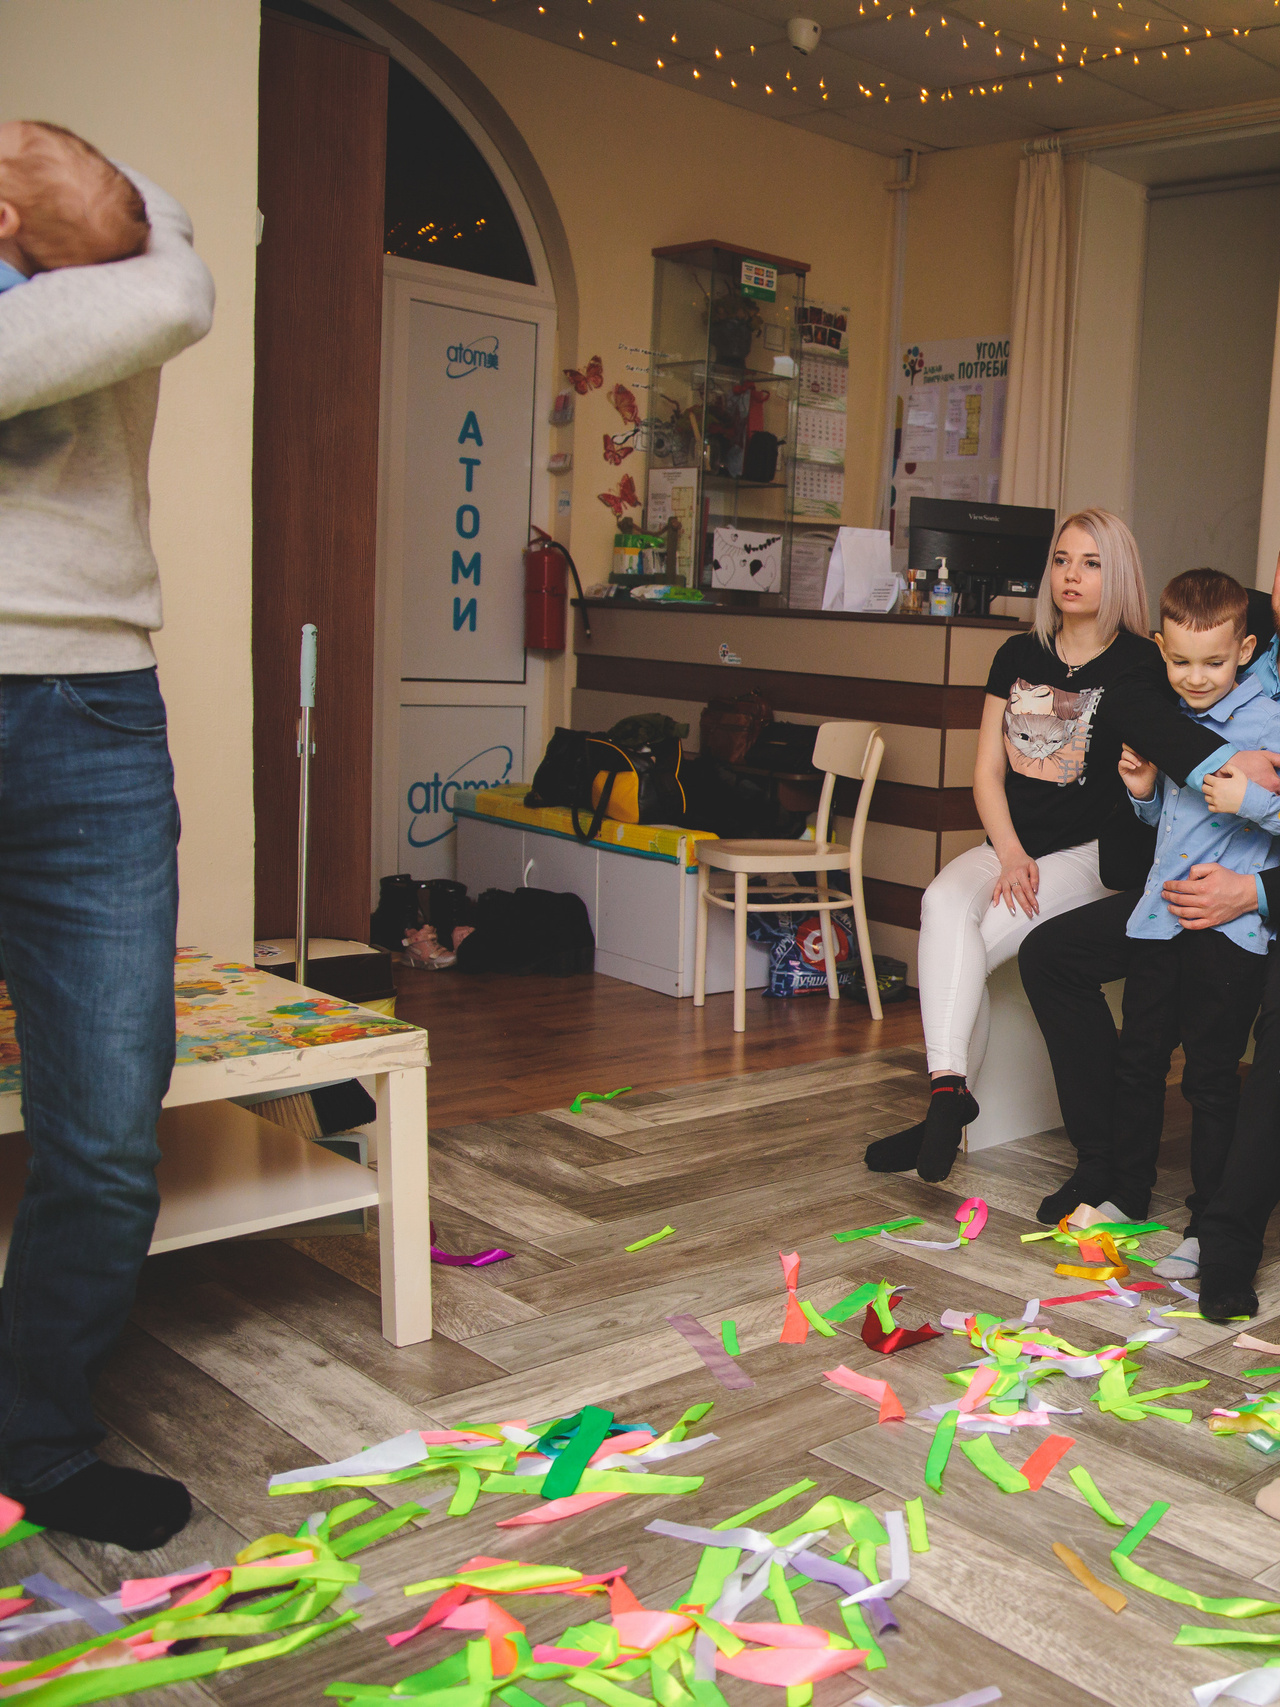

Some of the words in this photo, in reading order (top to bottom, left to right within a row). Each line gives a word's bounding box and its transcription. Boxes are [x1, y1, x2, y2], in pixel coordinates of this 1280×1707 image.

[976, 340, 1010, 360] УГОЛО
[958, 359, 1008, 379] ПОТРЕБИ
[451, 410, 484, 632] АТОМИ
[968, 513, 1001, 522] ViewSonic
[791, 975, 829, 988] ЛУЧША
